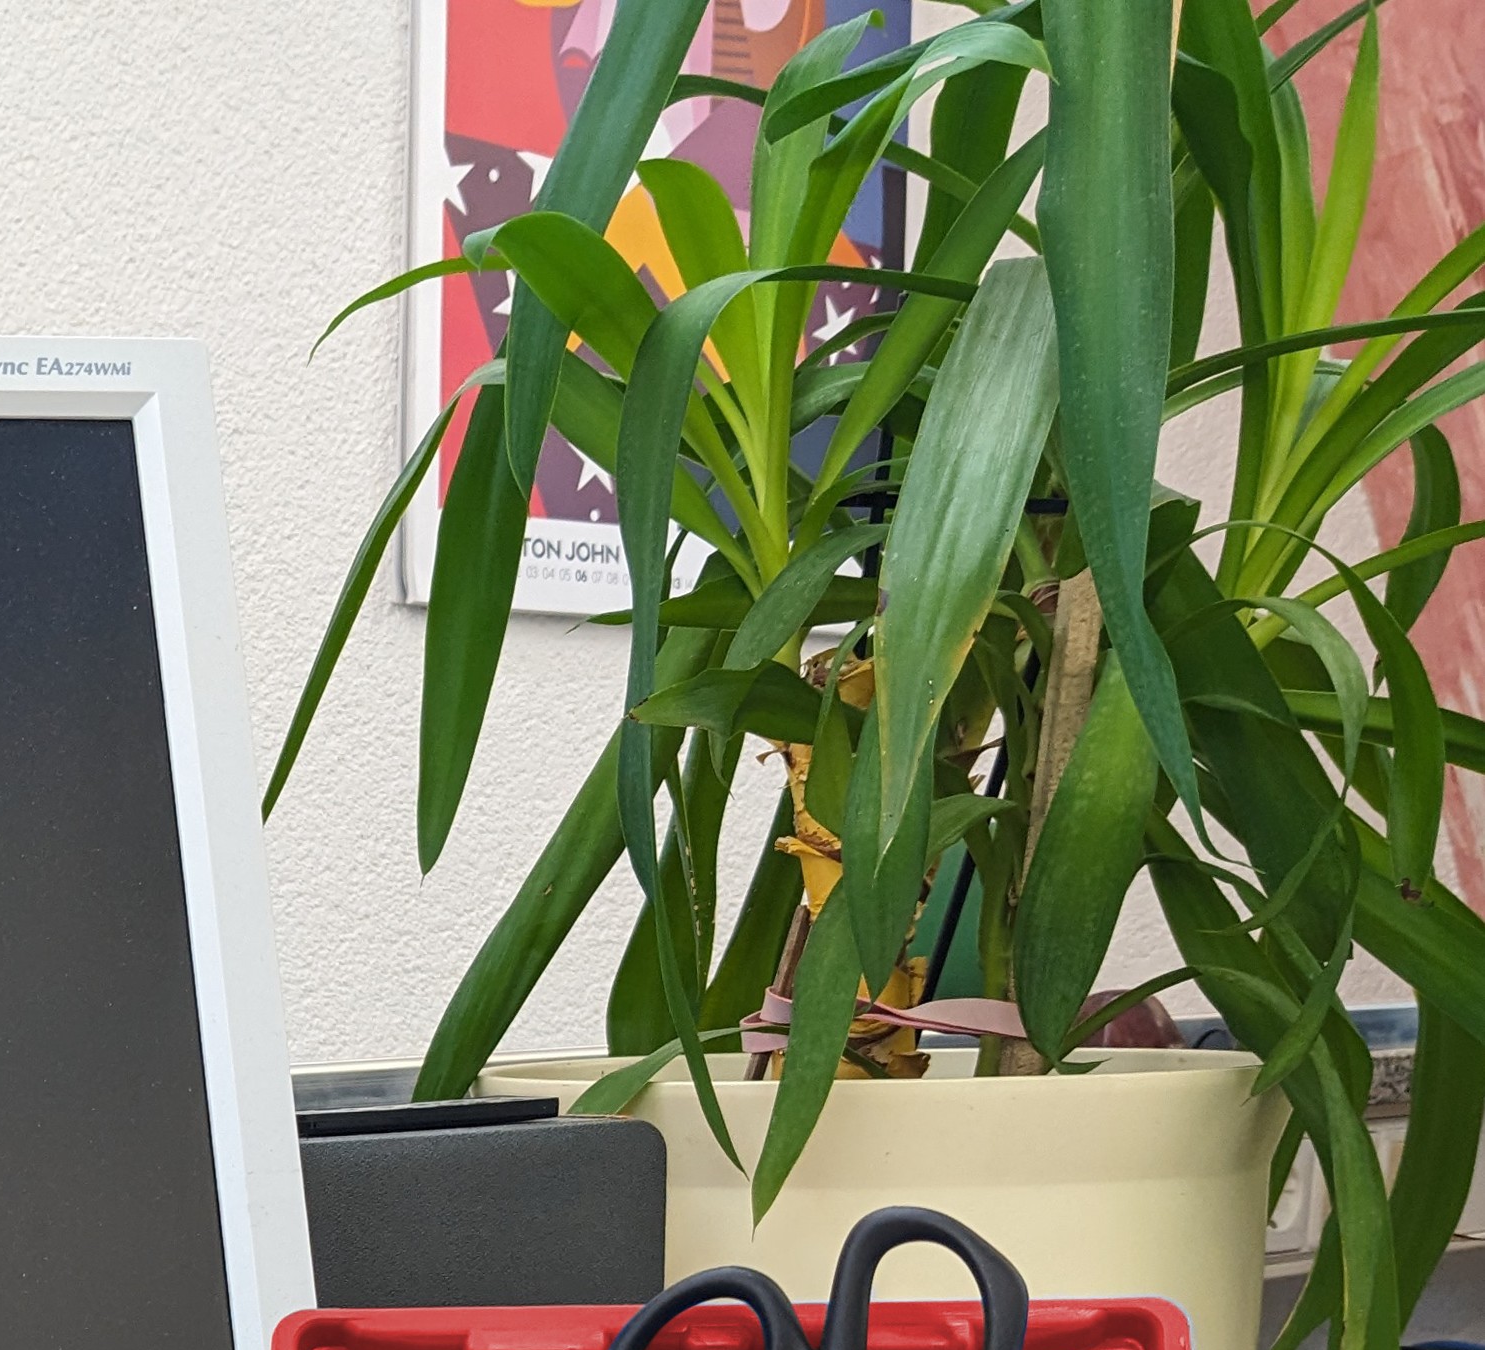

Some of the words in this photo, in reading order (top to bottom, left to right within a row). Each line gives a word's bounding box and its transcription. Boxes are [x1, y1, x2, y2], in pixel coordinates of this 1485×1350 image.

[35, 357, 132, 376] EA274WMi
[522, 537, 561, 559] TON
[565, 541, 620, 564] JOHN
[575, 569, 587, 583] 06
